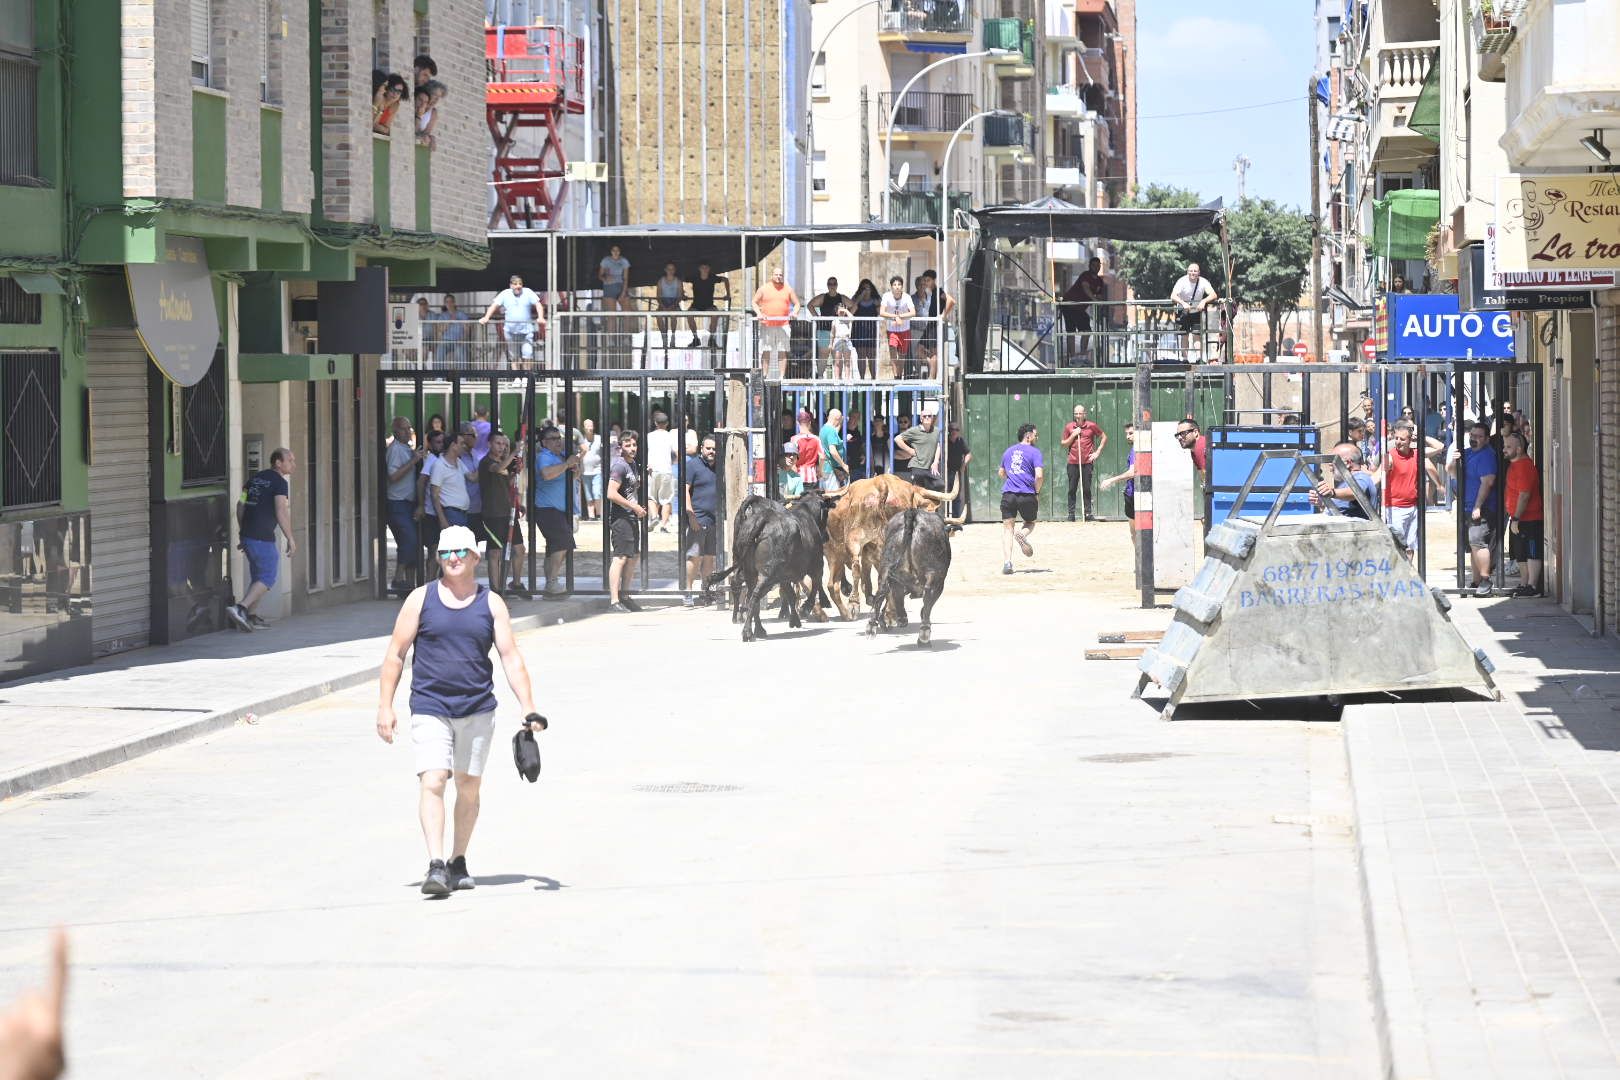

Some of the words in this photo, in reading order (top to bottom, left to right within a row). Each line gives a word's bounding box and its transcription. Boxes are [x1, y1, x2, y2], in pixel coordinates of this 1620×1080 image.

[1531, 232, 1576, 261] La
[1402, 314, 1483, 337] AUTO
[1240, 582, 1363, 608] BARRERAS
[1369, 580, 1425, 599] IVAN
